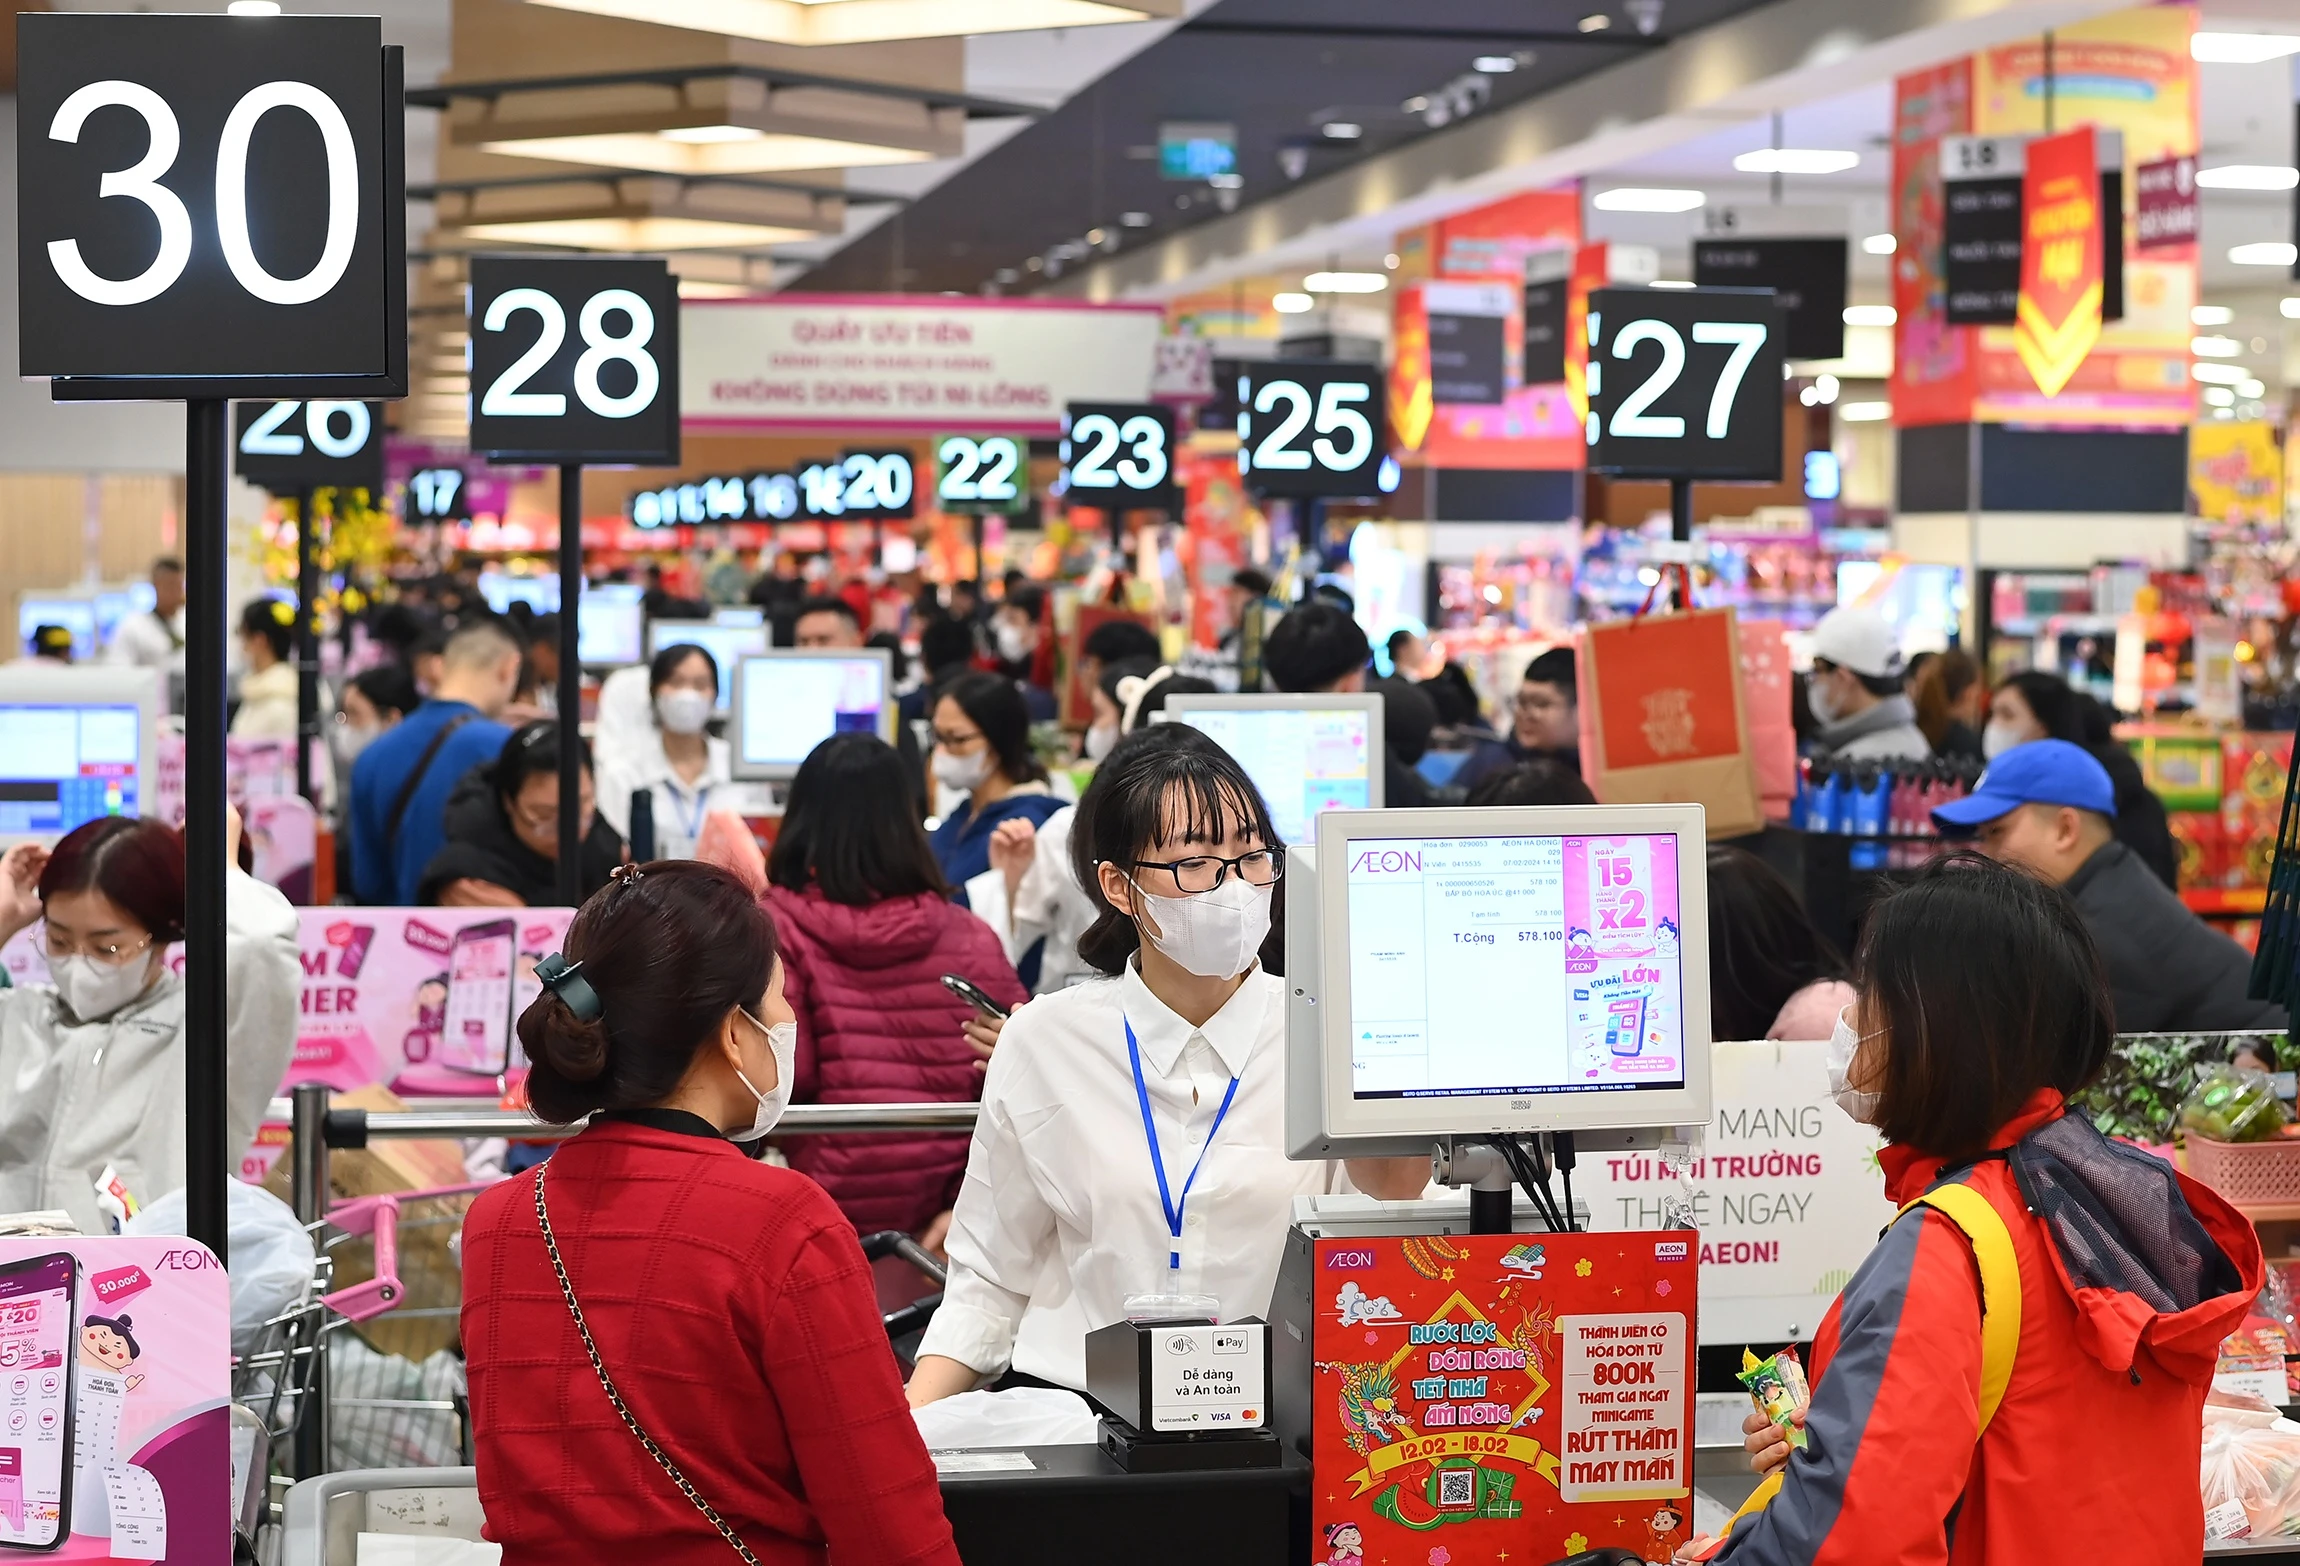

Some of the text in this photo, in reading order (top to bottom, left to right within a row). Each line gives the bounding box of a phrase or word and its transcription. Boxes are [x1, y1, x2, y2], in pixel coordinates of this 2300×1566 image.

[46, 80, 359, 306] 30
[480, 288, 660, 419] 28
[1608, 318, 1768, 439] 27
[239, 401, 371, 458] 26
[1253, 379, 1373, 472] 25
[1070, 414, 1167, 491] 23
[939, 437, 1018, 501] 22
[410, 469, 463, 516] 17
[842, 454, 912, 509] 20
[1458, 840, 1488, 848] 0290053
[1501, 839, 1522, 847] AEON
[1595, 848, 1614, 856] NGÀY
[1452, 859, 1482, 867] 0415535
[1597, 857, 1633, 887] 15
[1598, 889, 1646, 930] x2
[1453, 931, 1563, 945] T.Cộng 578.100
[1590, 963, 1660, 989] ƯU ĐÃI LỚN
[1719, 1106, 1822, 1139] MANG
[1607, 1153, 1650, 1182] TÚI
[1712, 1149, 1822, 1178] TRƯỜNG
[1723, 1192, 1814, 1226] NGAY
[1658, 1244, 1684, 1254] AEON
[1698, 1241, 1779, 1265] AEON!
[1410, 1321, 1497, 1344] RƯỚC LỘC
[1621, 1324, 1648, 1338] VIÊN
[1650, 1322, 1667, 1337] CÓ
[1226, 1338, 1243, 1348] Pay
[1586, 1342, 1613, 1358] HÓA
[1616, 1344, 1644, 1357] ĐƠN
[1430, 1347, 1526, 1371] ĐÓN RỒNG
[1183, 1368, 1233, 1382] Dễ dàng
[1593, 1361, 1655, 1385] 800K
[88, 1383, 104, 1393] THANH
[1175, 1384, 1241, 1396] và An toàn
[1413, 1376, 1486, 1400] TẾT NHÀ
[1578, 1389, 1670, 1404] THAM GIA NGAY
[1210, 1413, 1231, 1421] VISA
[1424, 1402, 1511, 1426] ẤM NỒNG
[1592, 1408, 1655, 1423] MINIGAME
[1400, 1438, 1446, 1461] 12.02
[1463, 1436, 1509, 1453] 18.02
[1568, 1425, 1678, 1454] RÚT THĂM
[1570, 1453, 1675, 1484] MAY MẮN
